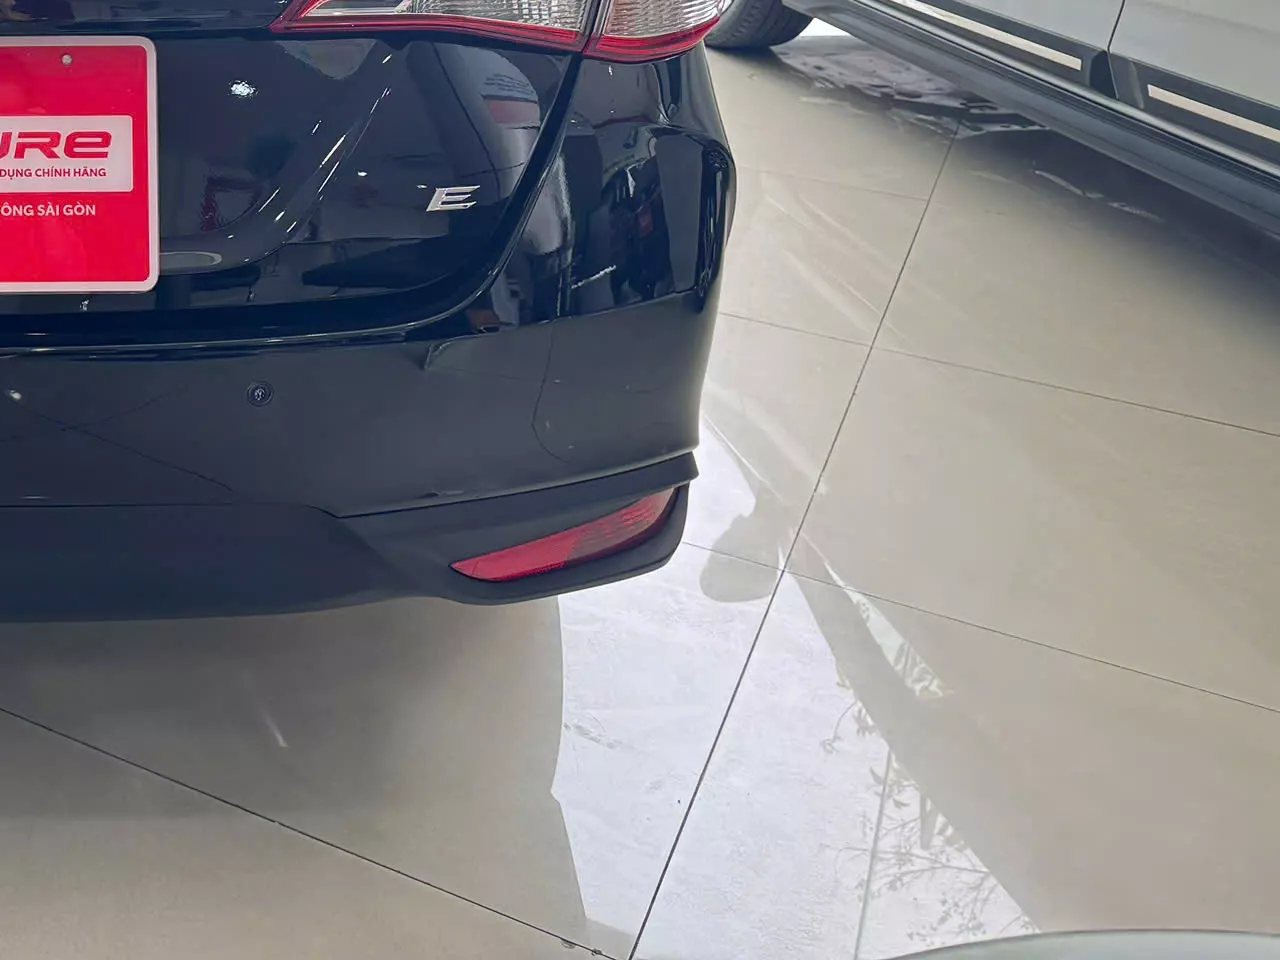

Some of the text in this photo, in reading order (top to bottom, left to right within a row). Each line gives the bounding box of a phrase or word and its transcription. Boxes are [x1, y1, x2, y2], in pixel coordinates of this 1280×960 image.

[0, 168, 32, 180] DỤNG
[35, 166, 70, 178] CHÍNH
[73, 167, 107, 177] HÃNG
[426, 185, 480, 212] E
[37, 203, 59, 217] SÀI
[63, 202, 96, 216] GÒN
